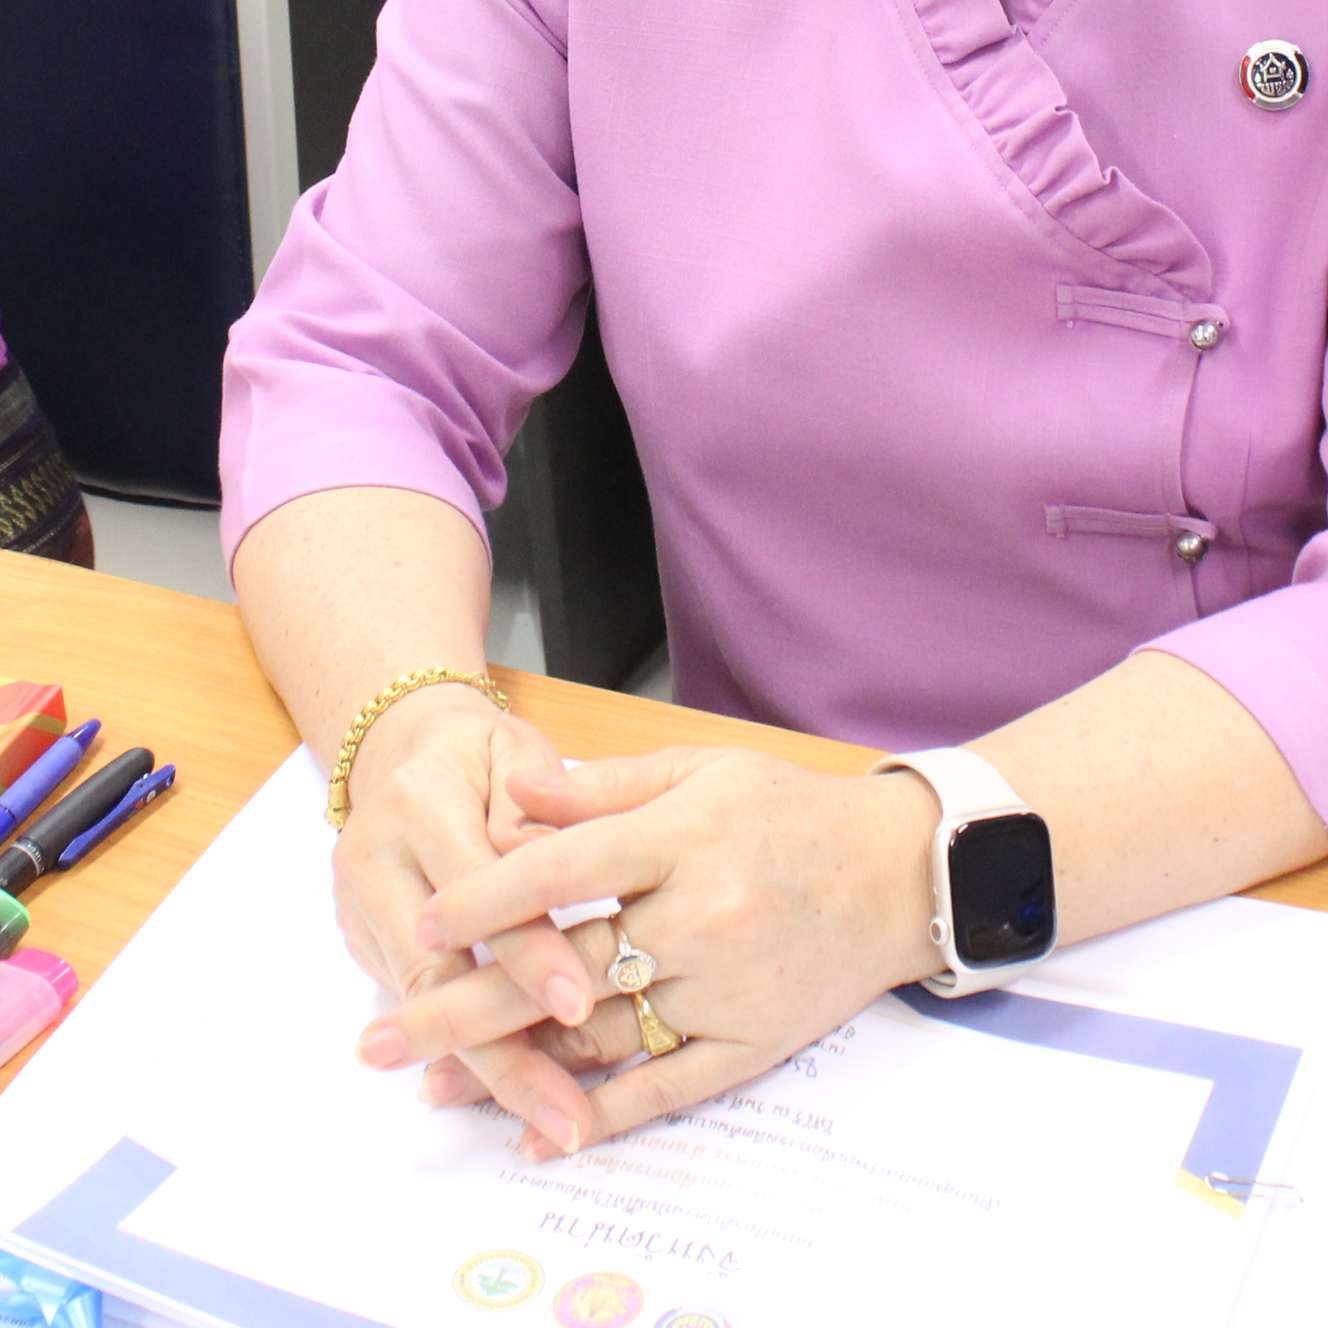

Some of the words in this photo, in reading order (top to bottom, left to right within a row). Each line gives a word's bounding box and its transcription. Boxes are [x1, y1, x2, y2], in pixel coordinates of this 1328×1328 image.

[539, 1211, 740, 1279] จังหวัดน่าน
